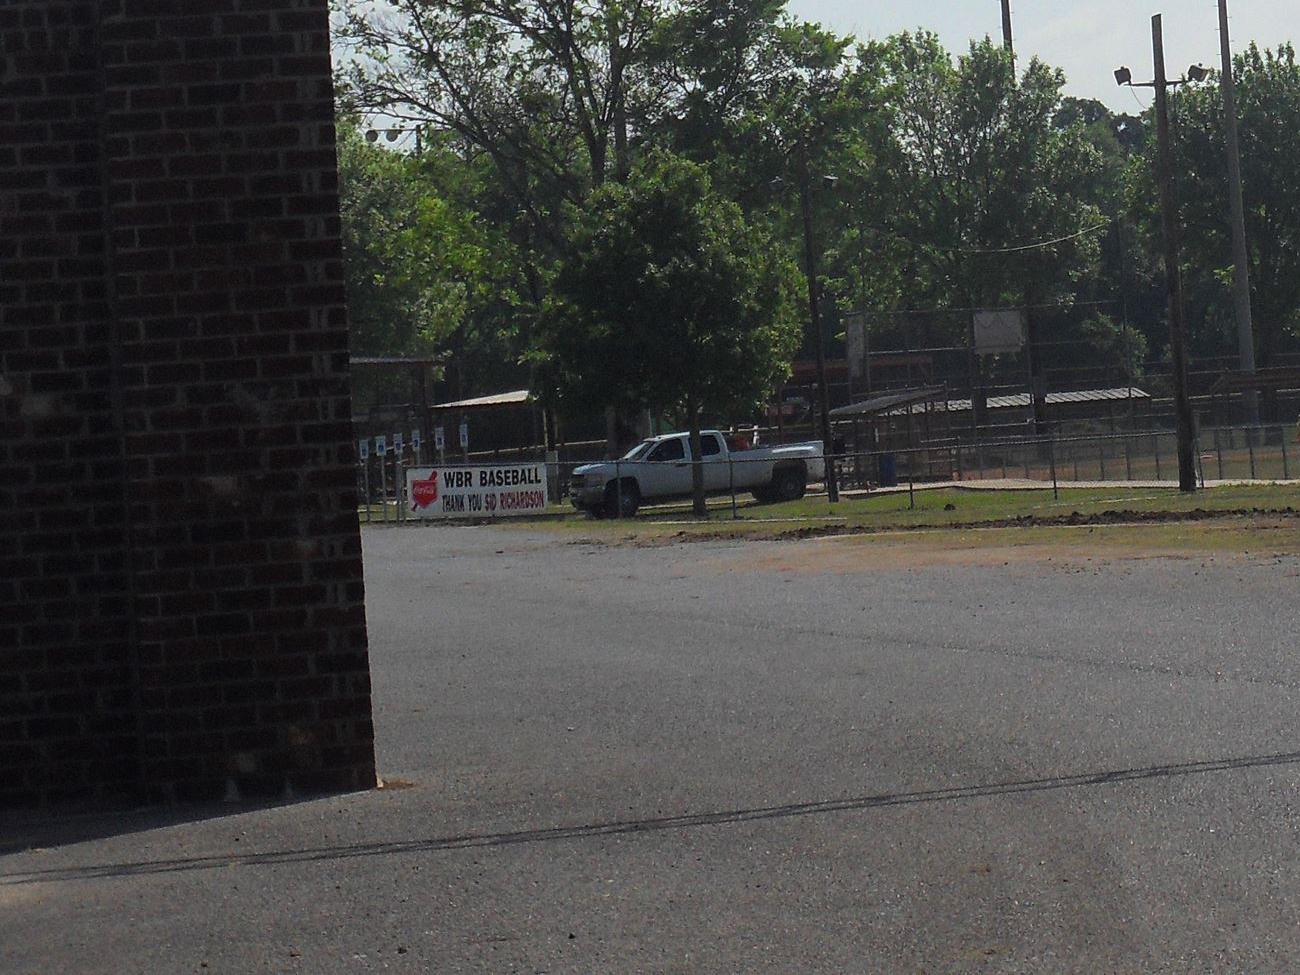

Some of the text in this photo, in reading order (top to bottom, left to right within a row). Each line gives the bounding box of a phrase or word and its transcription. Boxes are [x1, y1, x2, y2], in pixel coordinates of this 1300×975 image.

[444, 467, 541, 488] WBR BASEBALL
[442, 490, 545, 512] THANK YOU SID RICHARDSON
